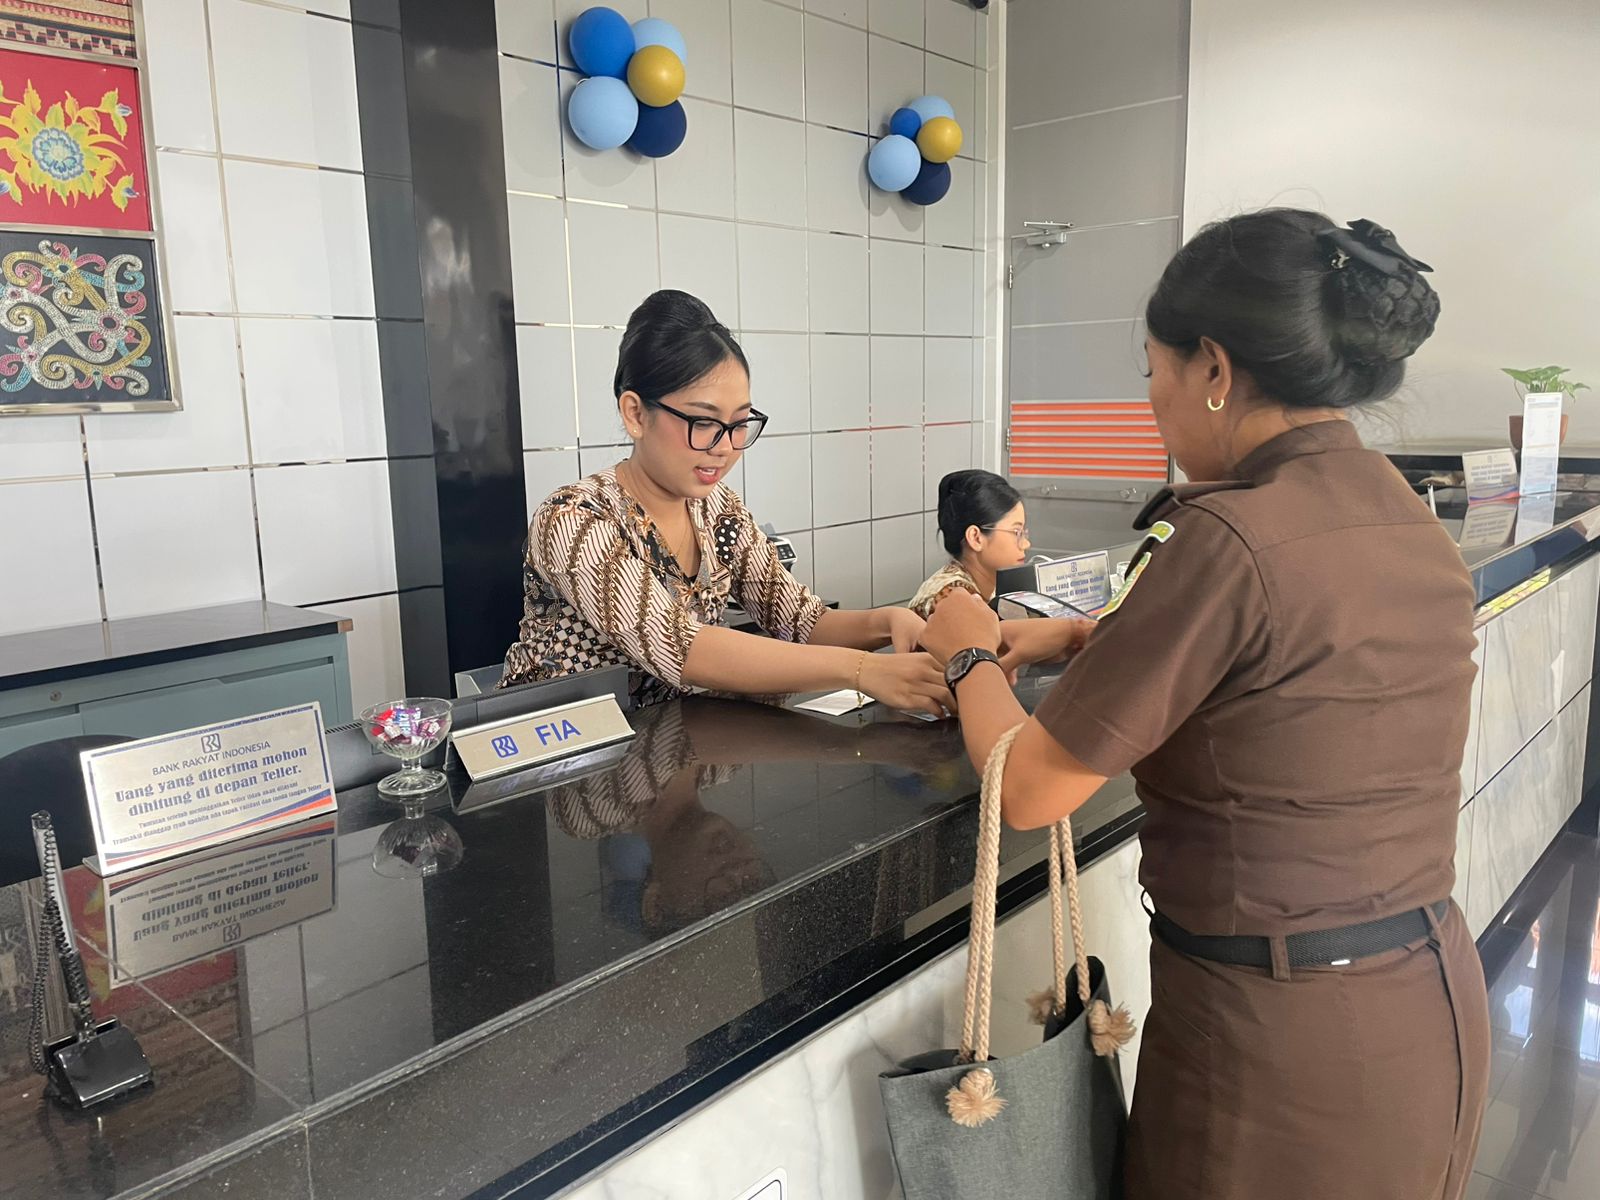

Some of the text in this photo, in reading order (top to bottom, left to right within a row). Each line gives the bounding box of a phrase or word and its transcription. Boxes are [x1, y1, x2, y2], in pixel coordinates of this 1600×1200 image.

[535, 719, 581, 746] FIA
[115, 746, 308, 802] Uang yang diterima mohon
[152, 740, 271, 776] BANK RAKYAT INDONESIA
[128, 764, 302, 817] dihitung di depan Teller.
